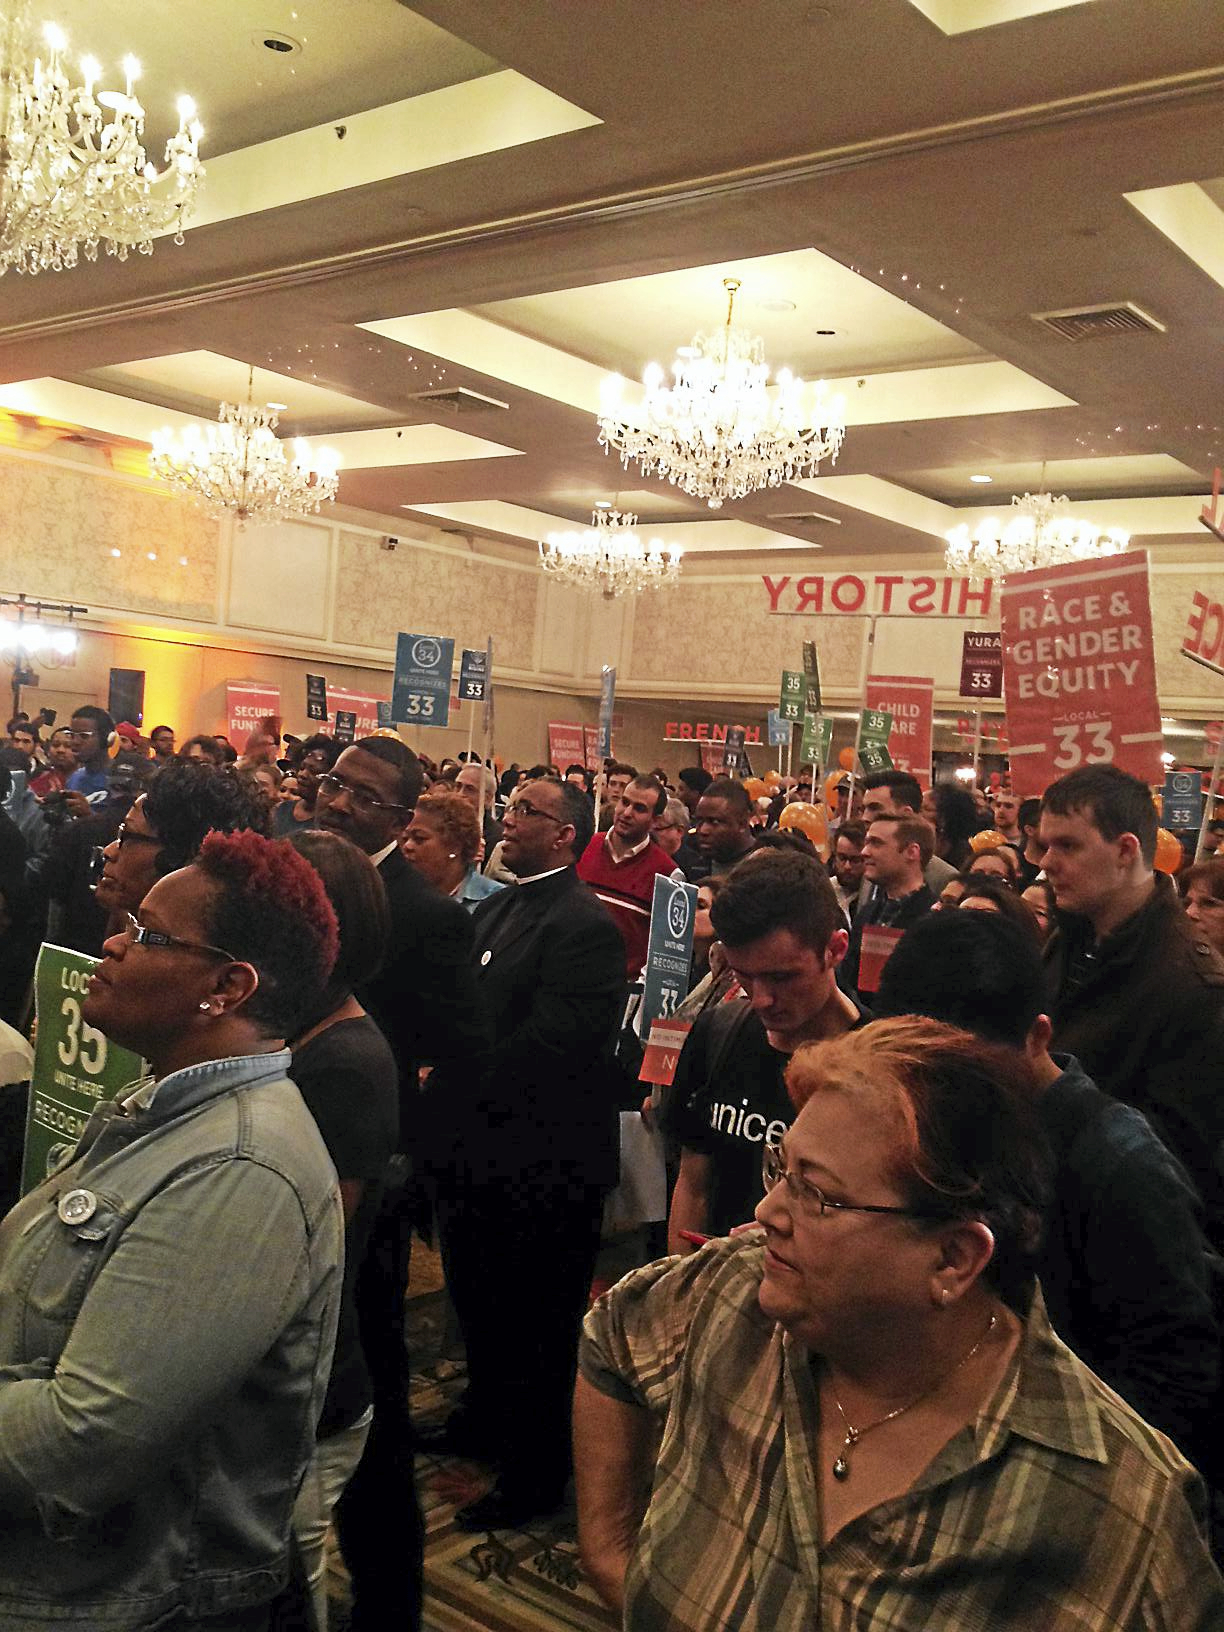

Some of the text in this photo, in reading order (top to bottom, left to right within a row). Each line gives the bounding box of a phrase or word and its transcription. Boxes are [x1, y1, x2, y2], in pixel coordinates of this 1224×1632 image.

[1018, 591, 1132, 631] RACE &
[1013, 624, 1144, 665] GENDER
[787, 677, 800, 690] 35
[971, 673, 992, 689] 33
[1018, 659, 1141, 699] EQUITY
[466, 683, 483, 696] 33
[234, 705, 275, 718] SECURE
[406, 694, 436, 717] 33
[785, 704, 799, 717] 33
[877, 702, 920, 718] CHILD
[868, 715, 885, 728] 35
[1063, 710, 1100, 722] LOCAL
[665, 721, 761, 743] FRENH
[890, 720, 917, 736] ARE
[1053, 721, 1115, 769] 33
[867, 752, 883, 766] 35
[1172, 809, 1191, 823] 33
[671, 906, 686, 929] 34
[61, 967, 90, 995] LOC
[58, 997, 108, 1075] 35
[35, 1099, 86, 1136] RECOGN
